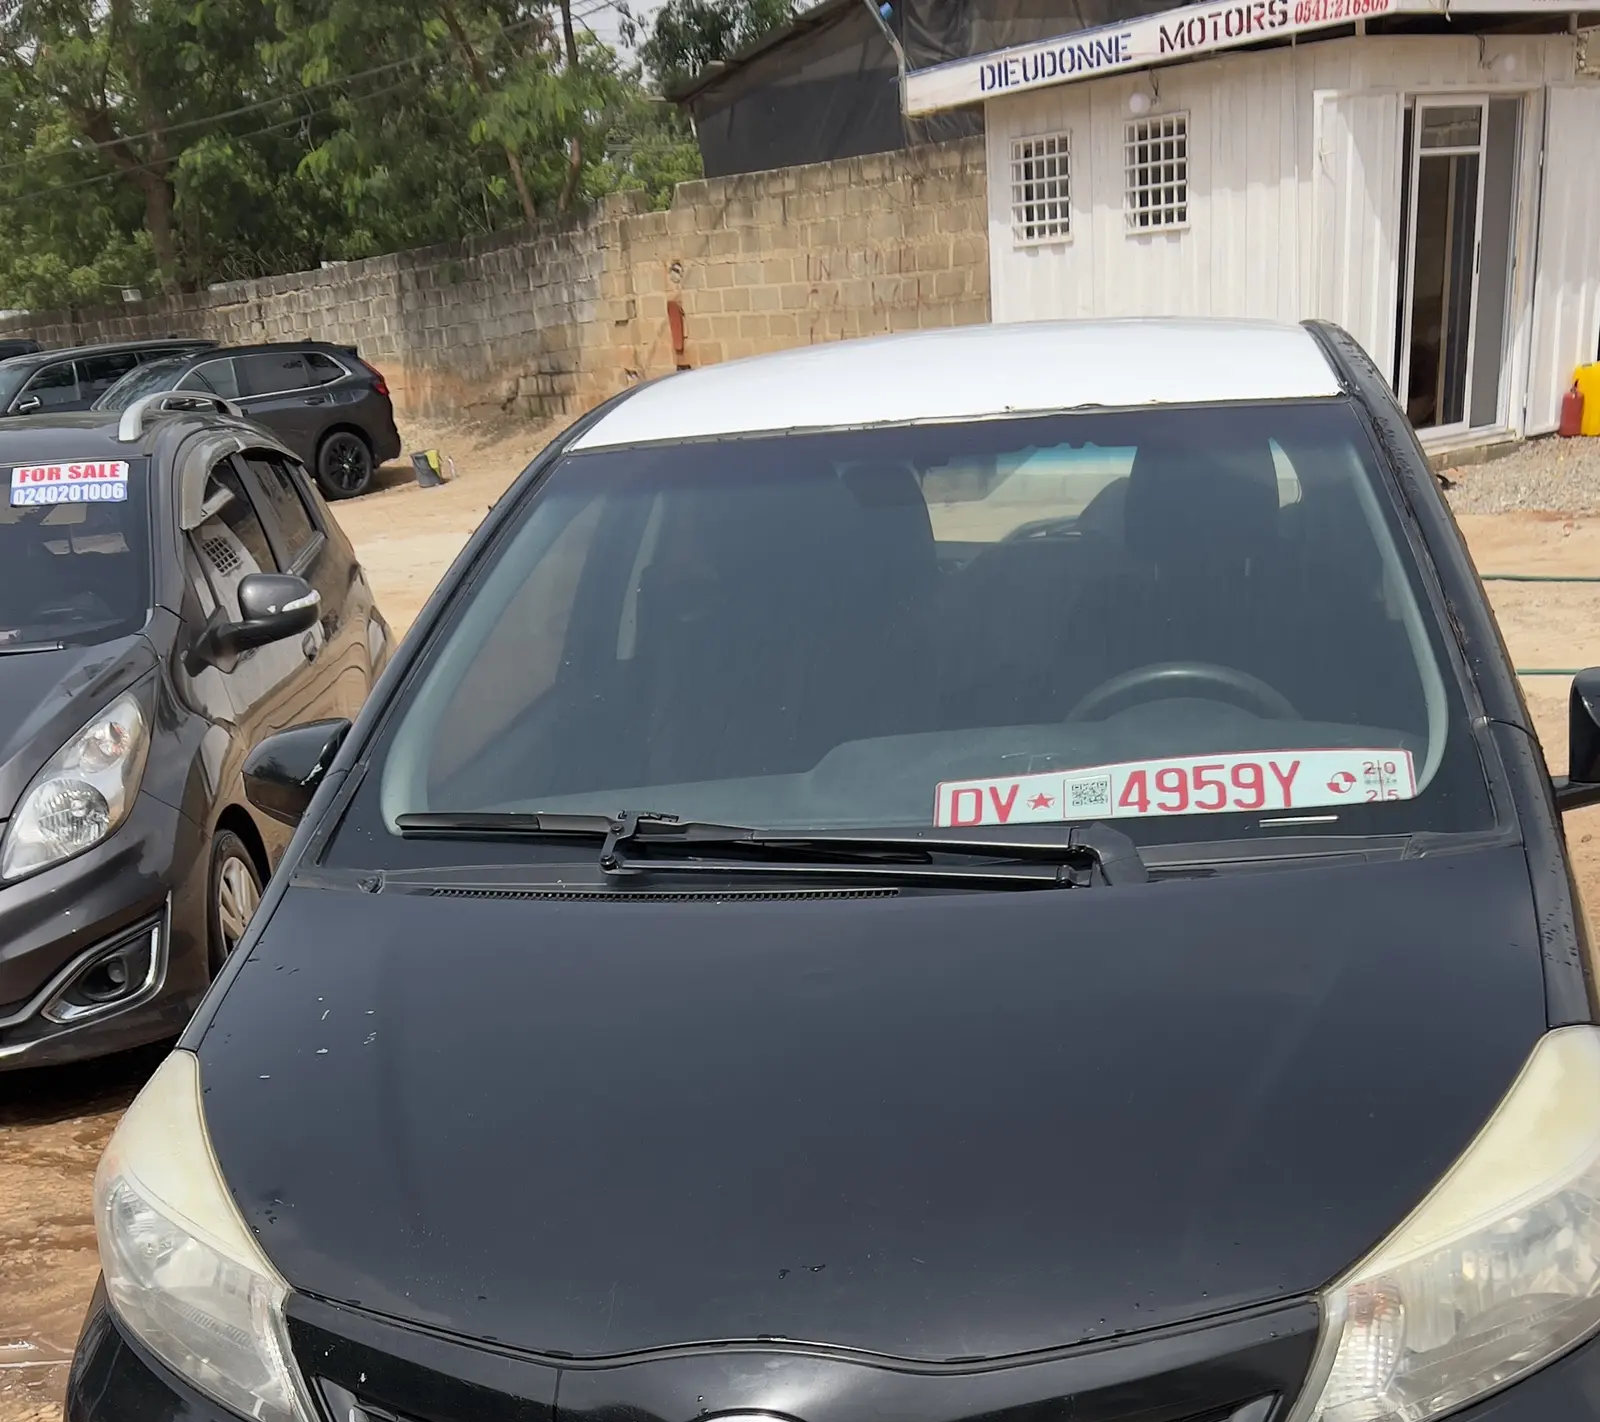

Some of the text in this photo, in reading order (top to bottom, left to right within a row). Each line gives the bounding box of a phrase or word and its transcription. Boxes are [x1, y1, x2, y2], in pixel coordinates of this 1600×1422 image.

[979, 32, 1133, 92] DIEUDONNE
[1159, 0, 1288, 53] MOTORS
[14, 482, 125, 505] 0240201006
[20, 463, 120, 483] FOR SALE
[950, 784, 1019, 828] DV
[1117, 760, 1301, 813] 4959Y
